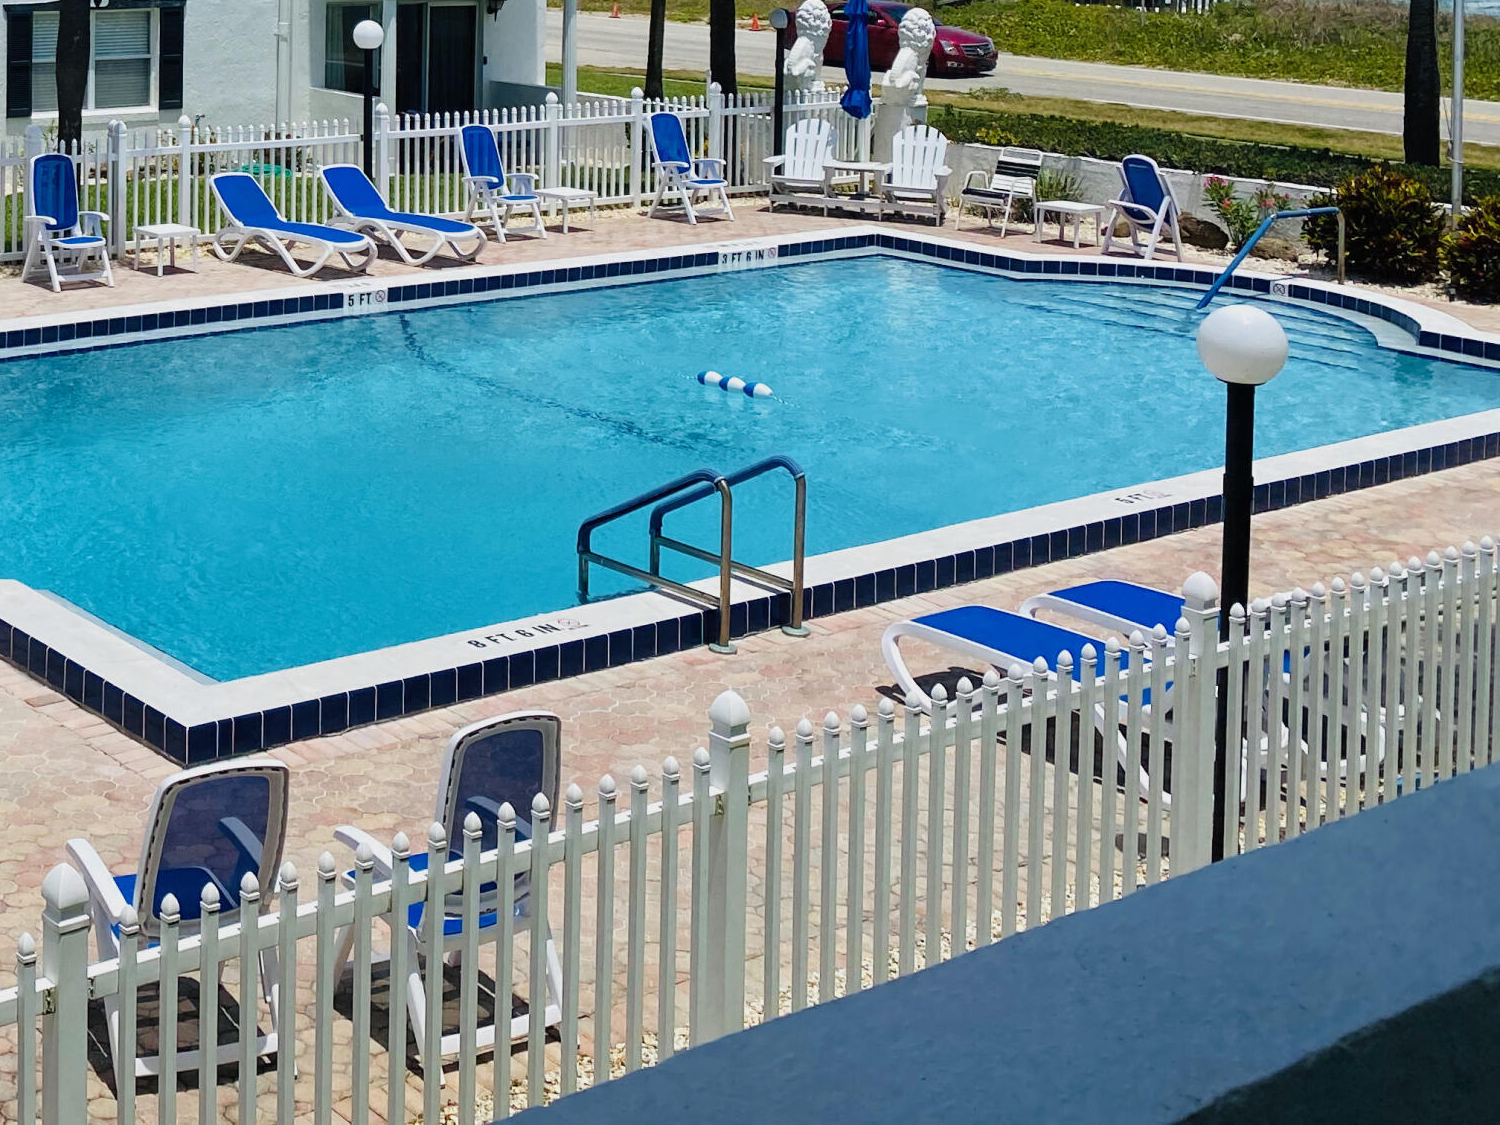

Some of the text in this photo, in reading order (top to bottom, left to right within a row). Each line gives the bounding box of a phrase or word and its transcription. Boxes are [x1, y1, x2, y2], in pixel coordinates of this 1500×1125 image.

[721, 253, 728, 264] 3
[731, 252, 742, 263] FT
[755, 249, 765, 260] IN
[348, 292, 372, 307] 5 FT
[484, 633, 515, 644] FT
[531, 623, 561, 634] IN
